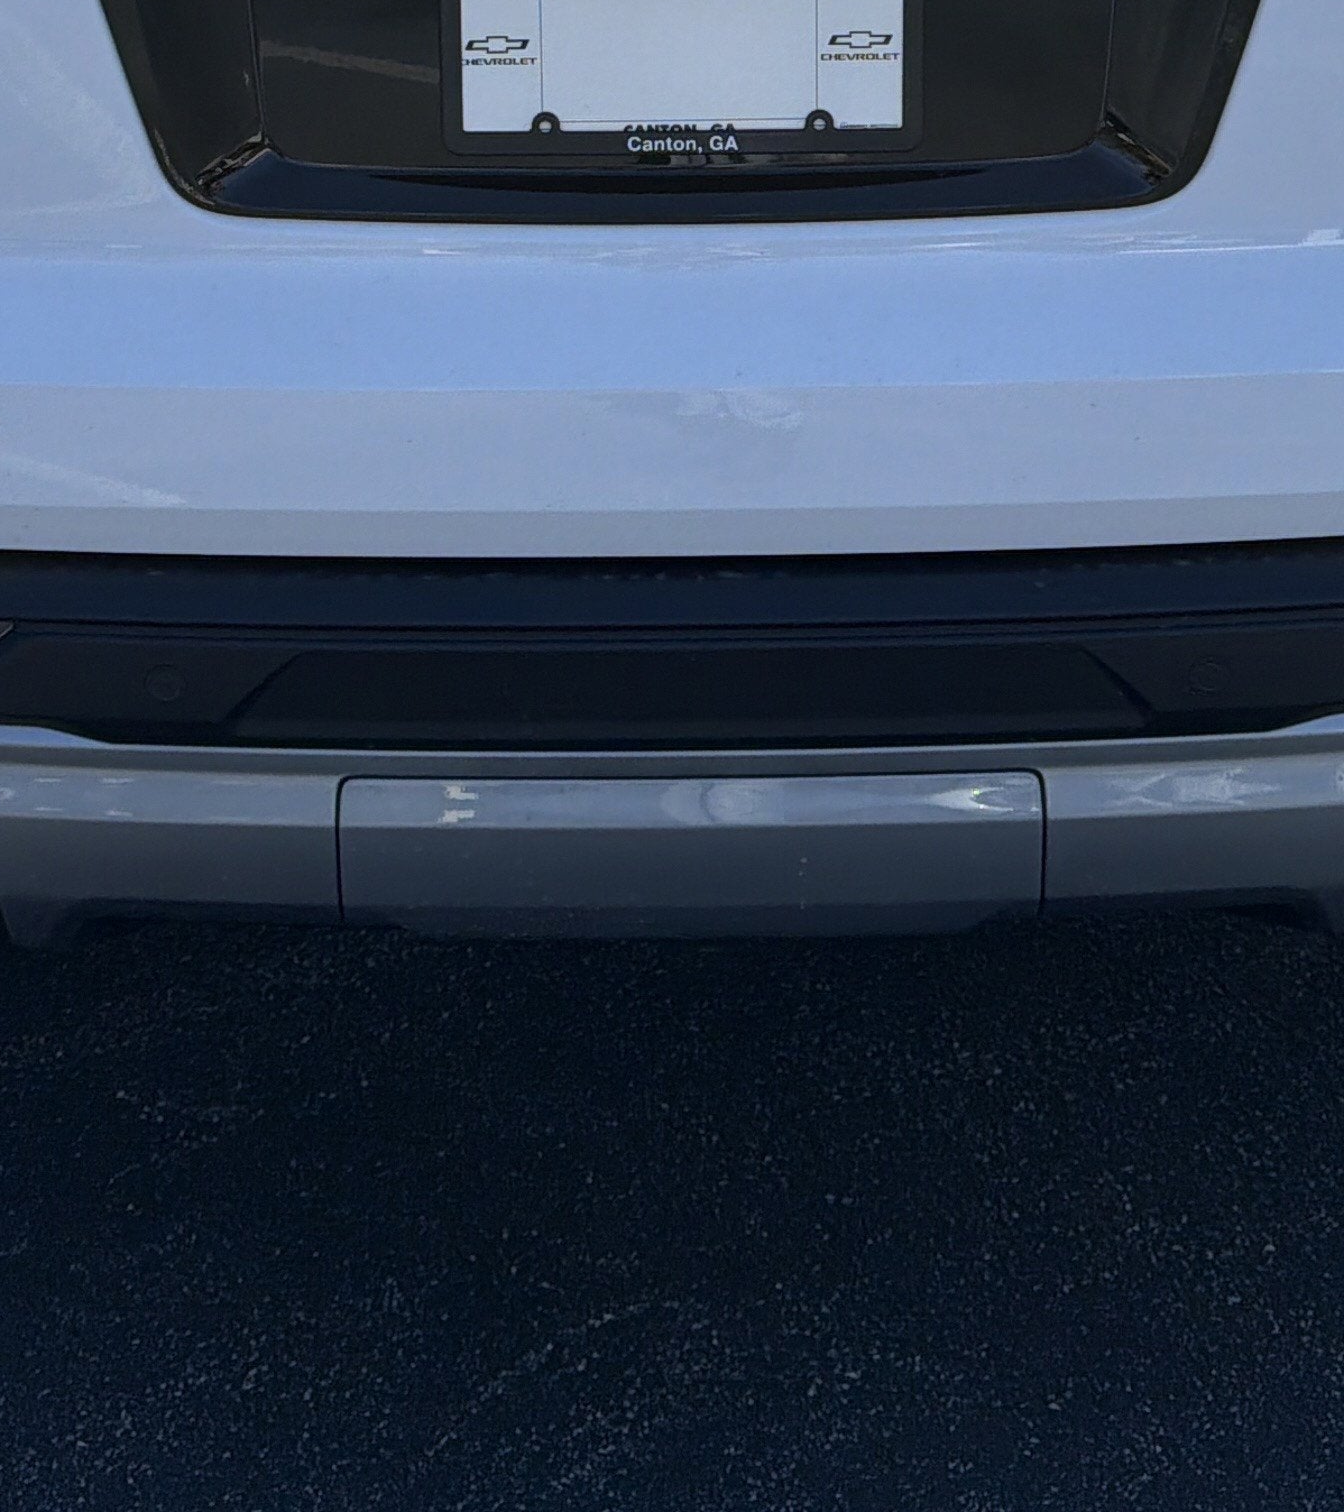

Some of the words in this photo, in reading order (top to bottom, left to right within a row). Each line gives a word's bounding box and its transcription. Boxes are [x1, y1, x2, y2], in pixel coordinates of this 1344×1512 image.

[820, 53, 900, 61] CHEVROLET
[627, 136, 703, 154] Canton,
[709, 135, 739, 152] GA
